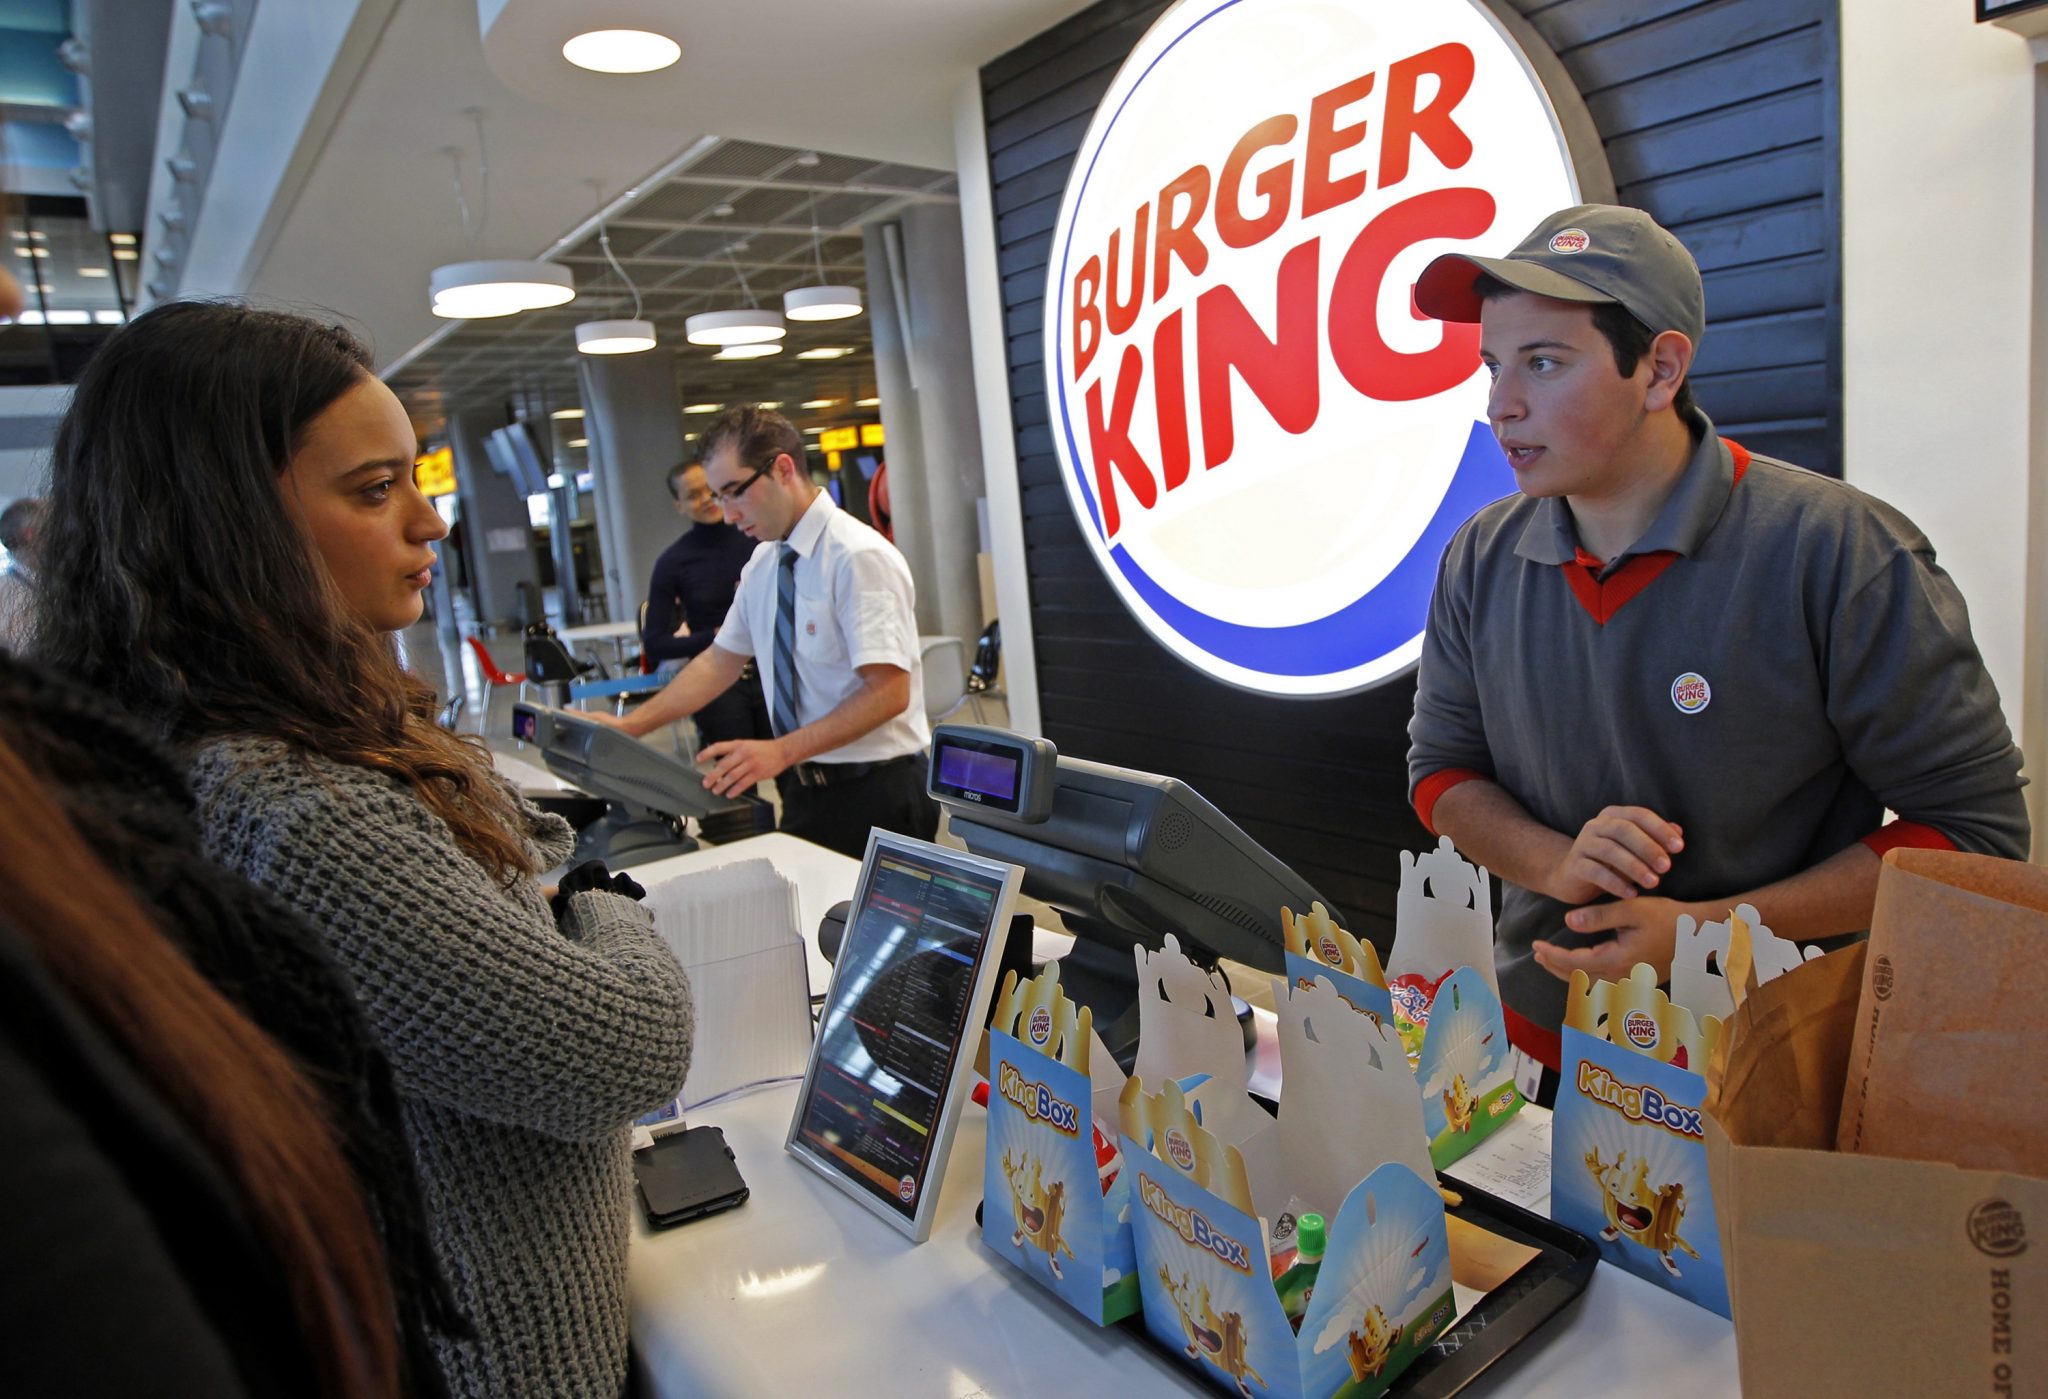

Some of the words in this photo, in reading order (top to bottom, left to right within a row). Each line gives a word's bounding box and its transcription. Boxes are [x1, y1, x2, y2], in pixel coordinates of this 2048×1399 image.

[1074, 42, 1475, 383] BURGER
[1554, 239, 1584, 248] KING
[1085, 187, 1497, 539] KING
[1676, 682, 1705, 693] BURGER
[1678, 689, 1705, 701] KING
[1032, 1014, 1050, 1023] BURGER
[1628, 1019, 1655, 1027] BURGER
[1031, 1021, 1050, 1033] KING
[1628, 1026, 1656, 1037] KING
[1168, 1136, 1190, 1150] BURGER
[1170, 1145, 1192, 1160] KING
[1990, 1268, 2012, 1354] HOME
